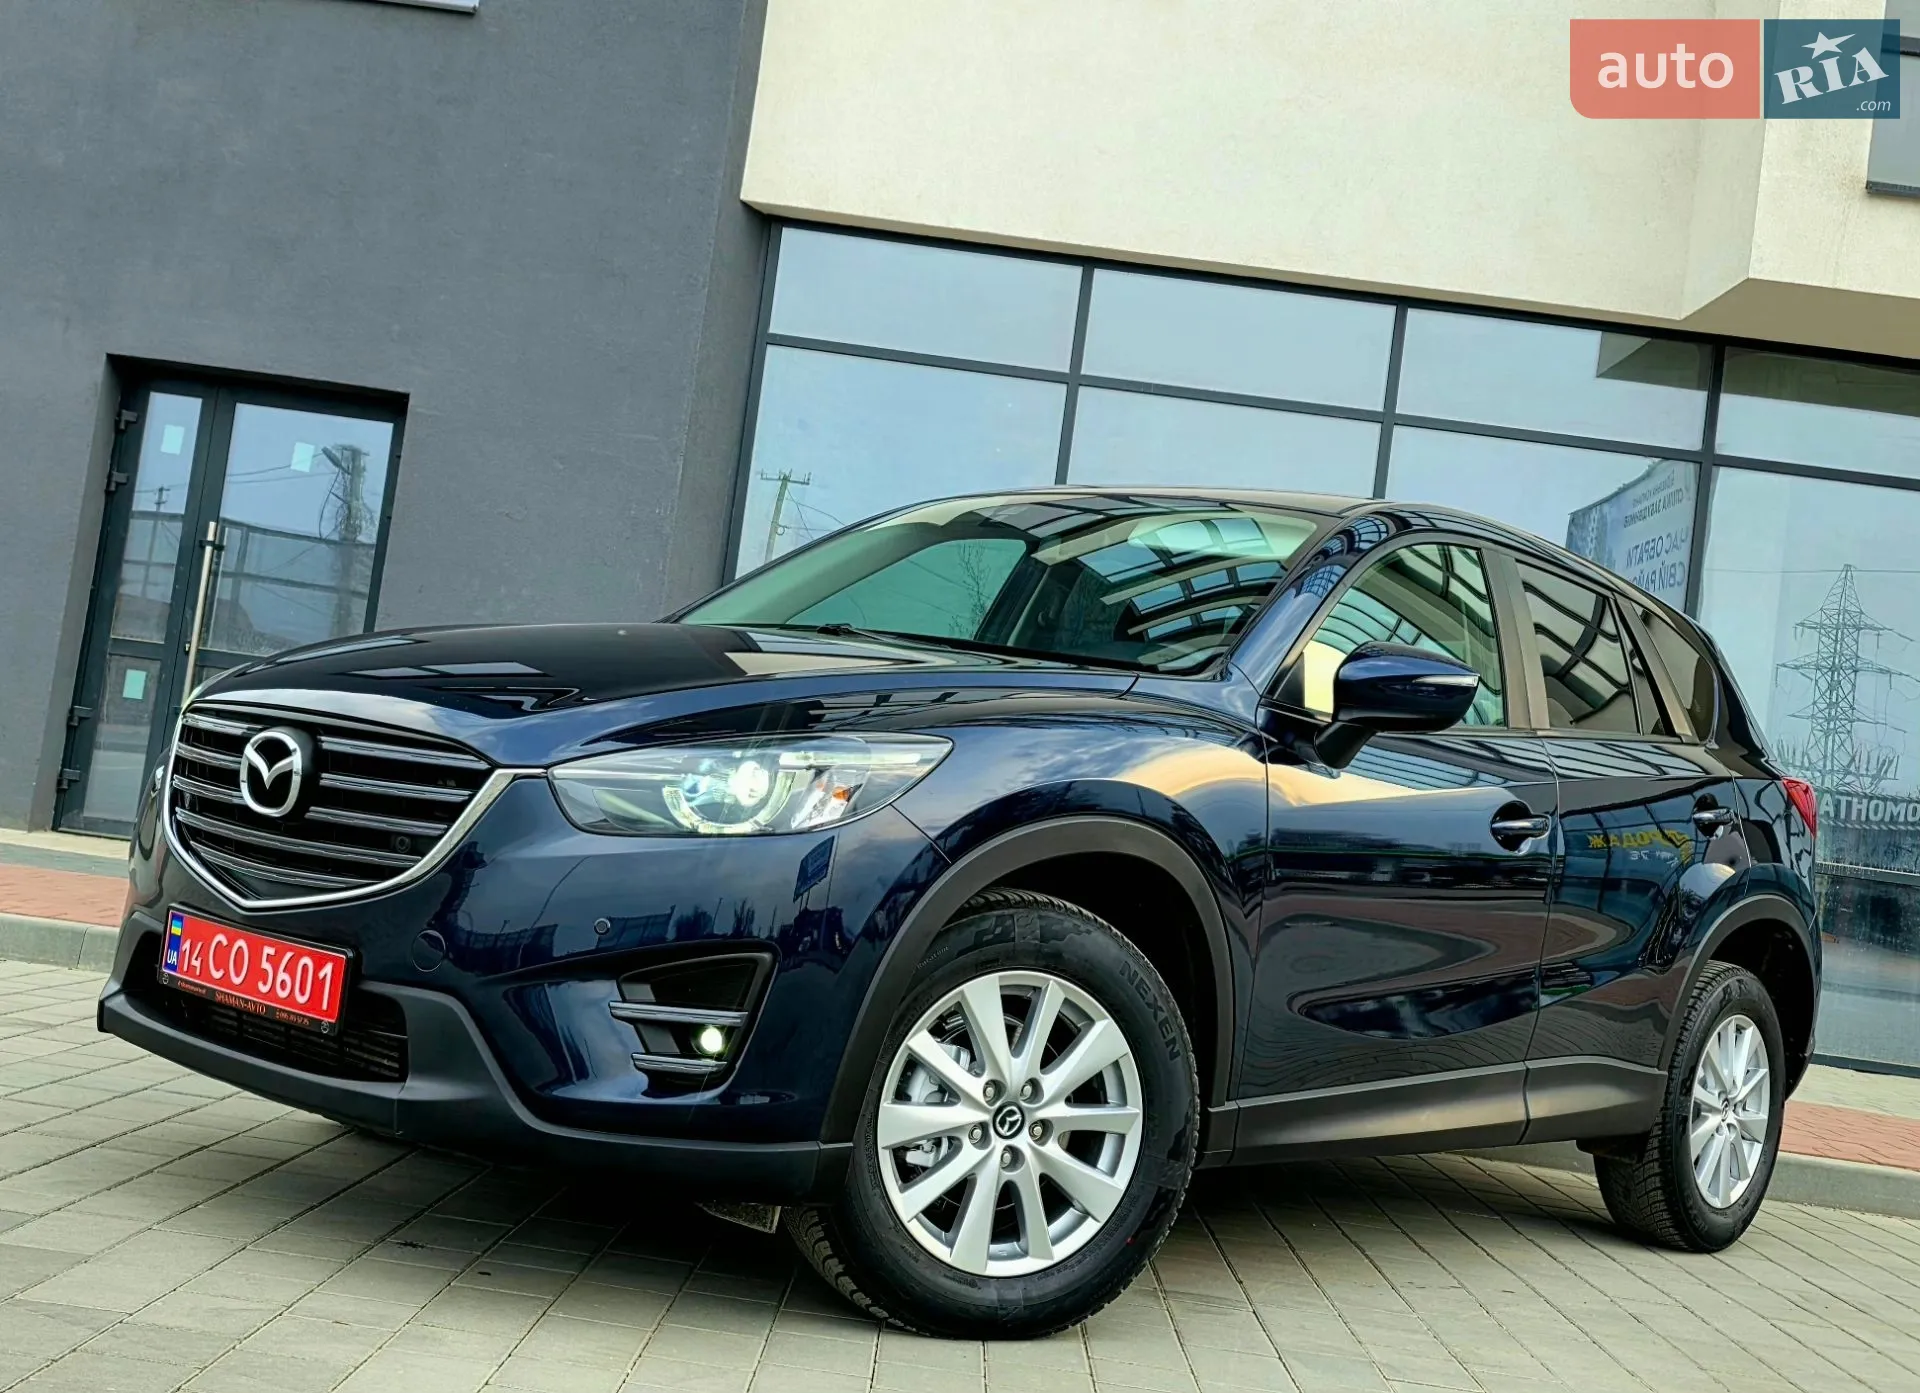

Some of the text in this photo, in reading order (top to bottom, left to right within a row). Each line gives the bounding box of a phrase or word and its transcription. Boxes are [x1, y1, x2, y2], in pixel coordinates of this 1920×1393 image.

[167, 951, 177, 966] UA
[182, 933, 334, 1011] 14 CO 5601
[1119, 960, 1181, 1062] NEXEN
